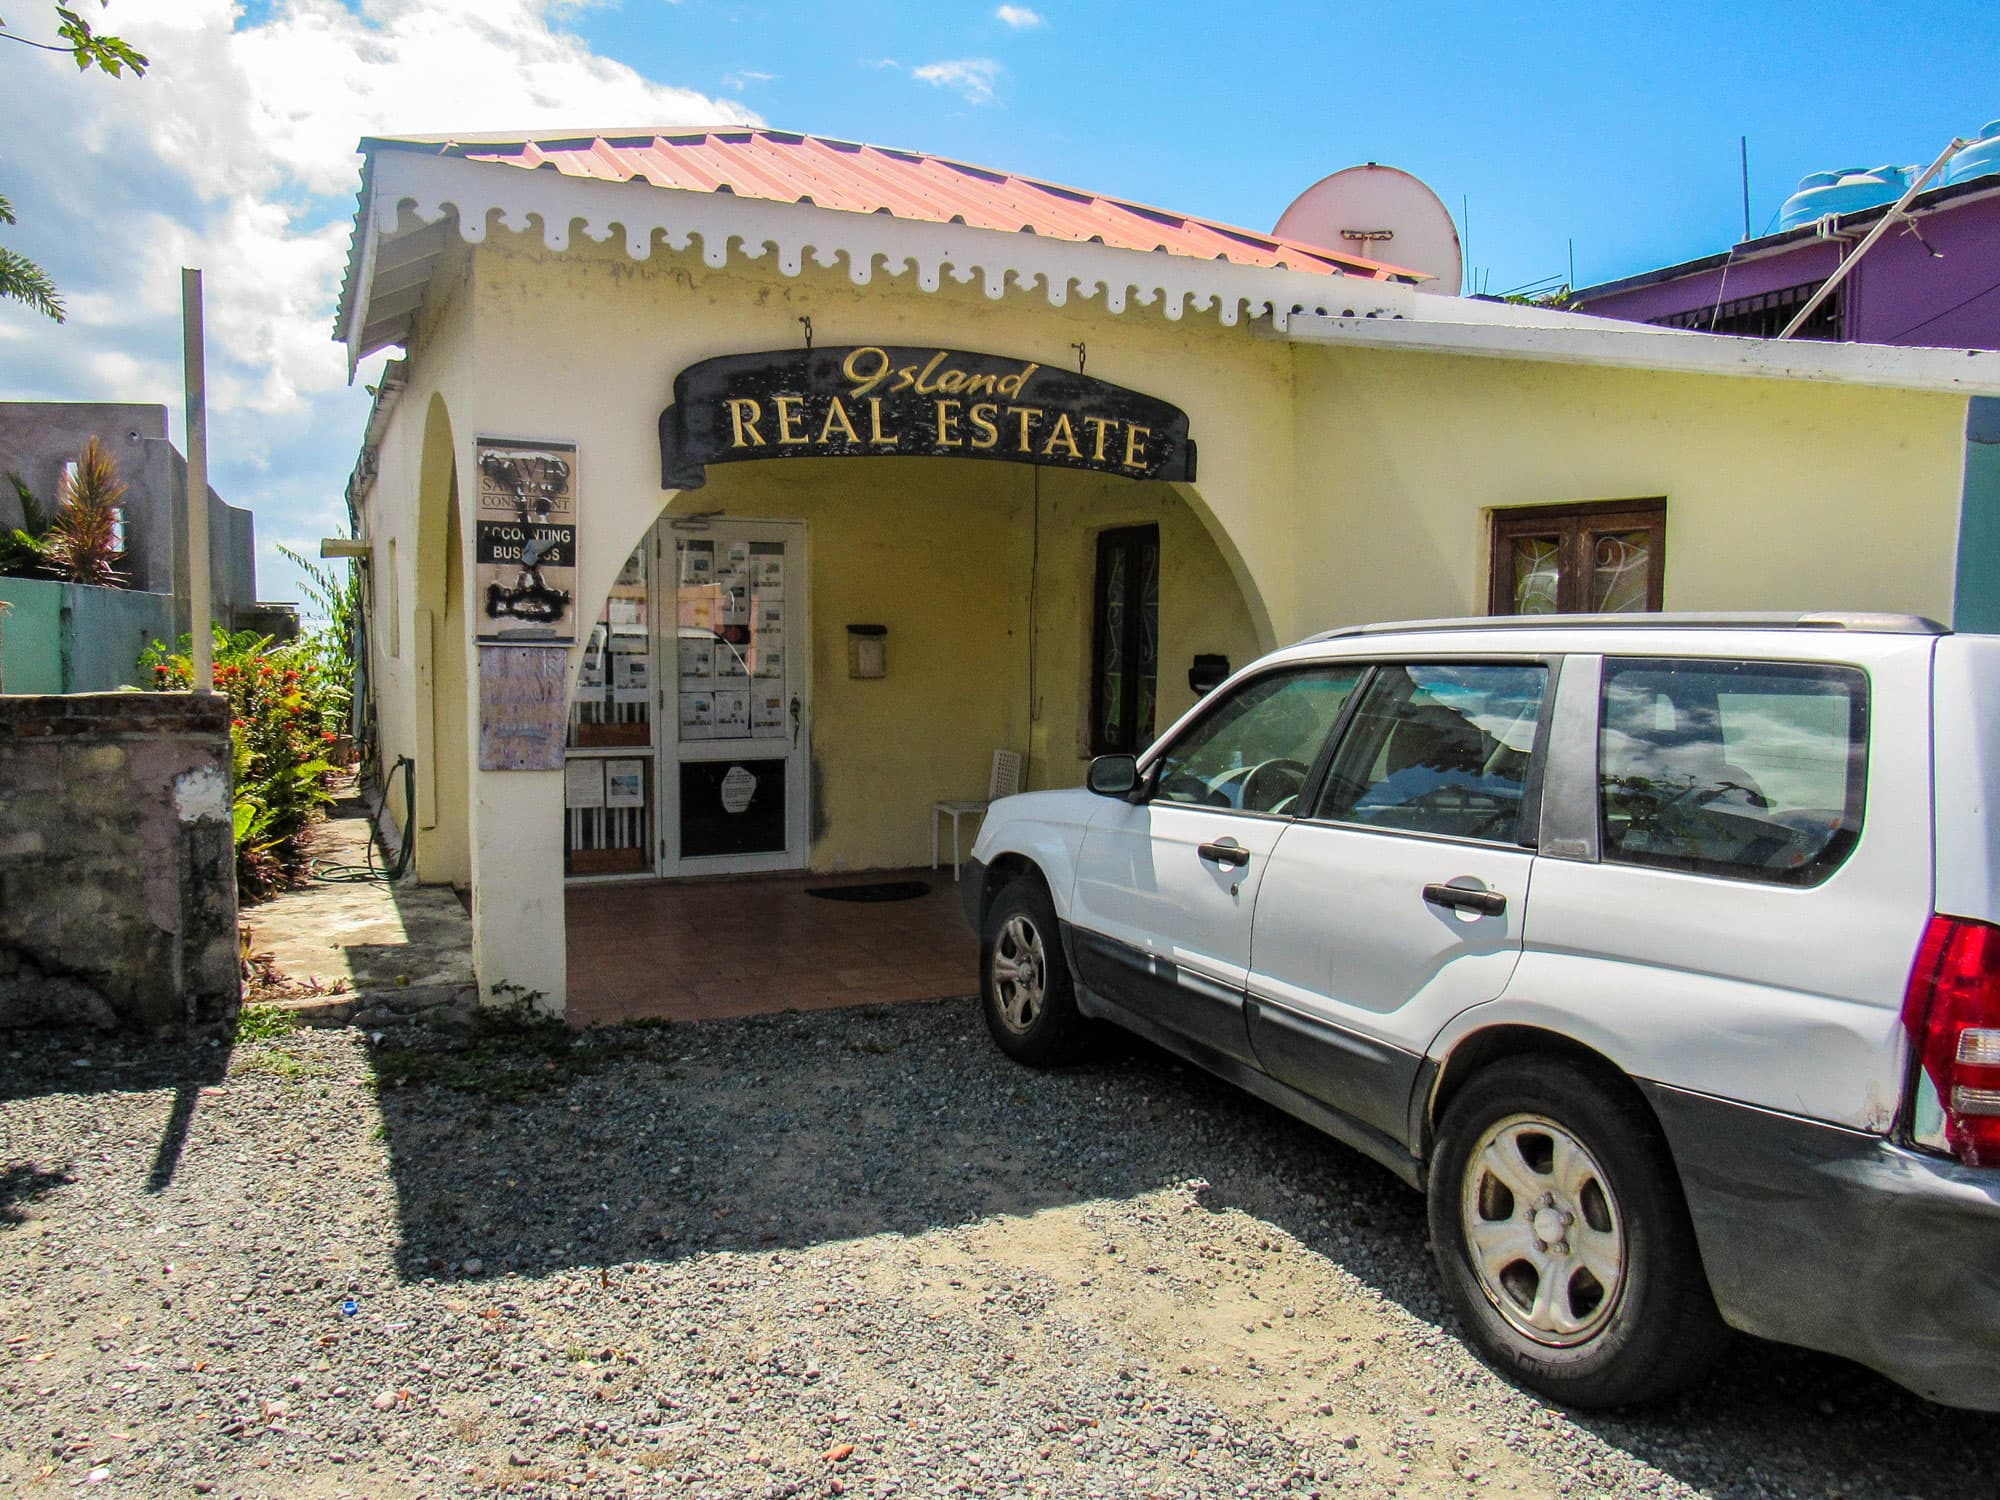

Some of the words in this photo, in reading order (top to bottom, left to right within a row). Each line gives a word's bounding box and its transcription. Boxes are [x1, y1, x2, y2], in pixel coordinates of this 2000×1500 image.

[842, 346, 1040, 400] Island
[727, 395, 899, 448] REAL
[936, 399, 1152, 470] ESTATE
